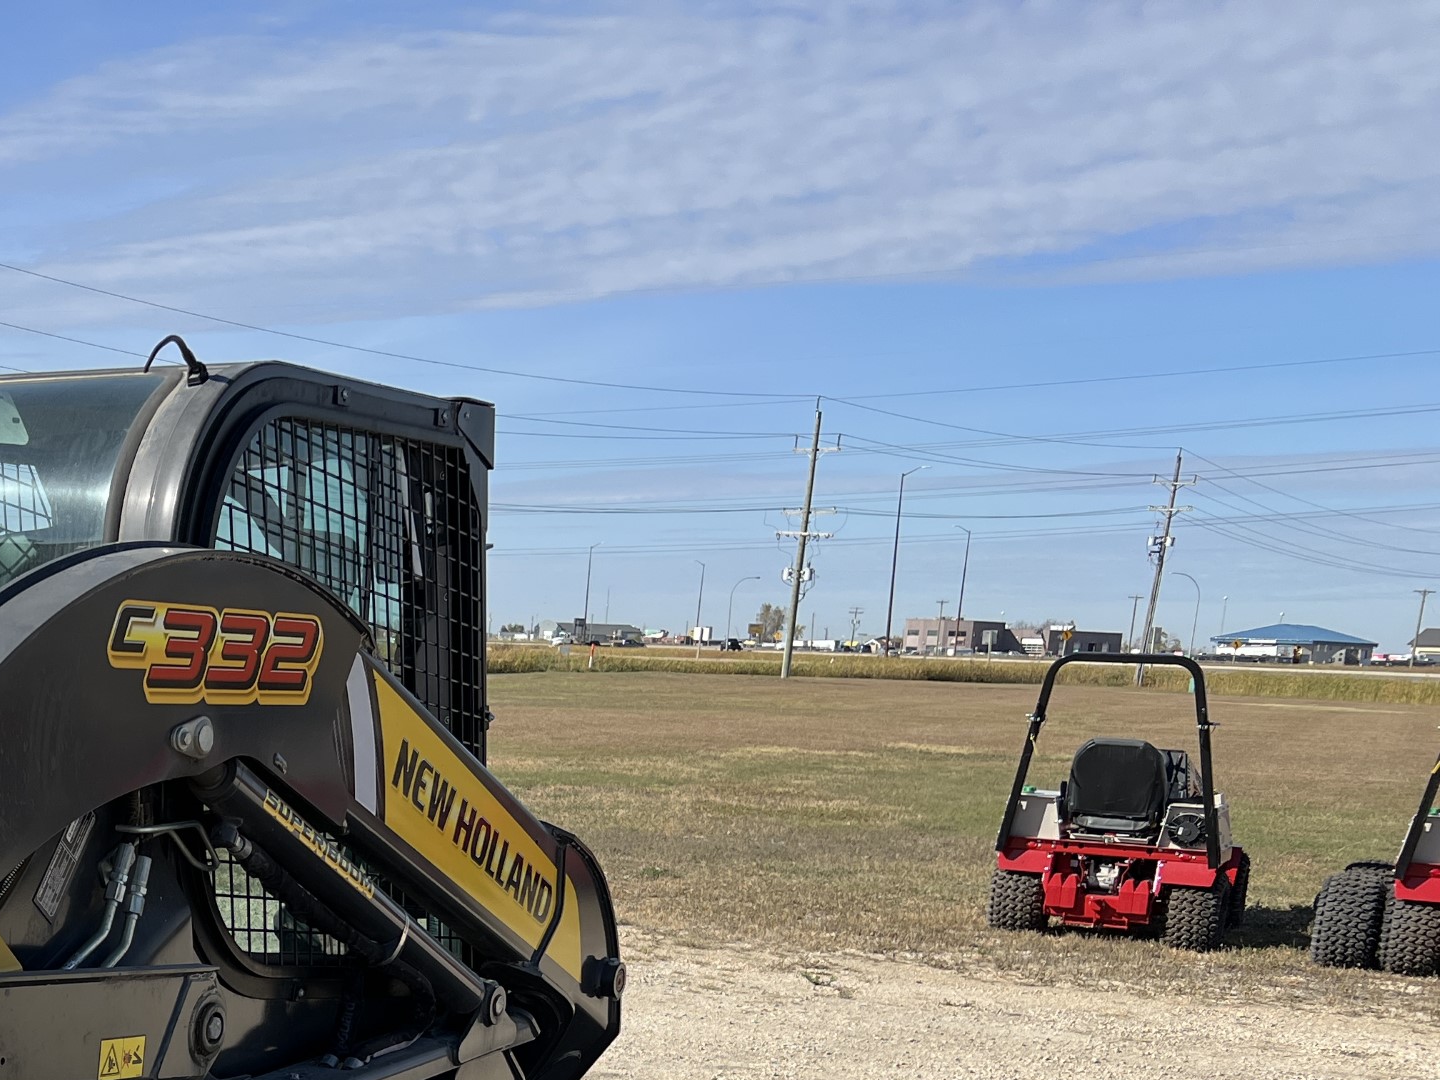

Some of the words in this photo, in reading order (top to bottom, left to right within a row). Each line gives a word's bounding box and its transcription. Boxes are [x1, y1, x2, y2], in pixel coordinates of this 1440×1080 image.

[107, 599, 324, 705] C332
[391, 737, 457, 835] NEW
[452, 799, 554, 925] HOLLAND
